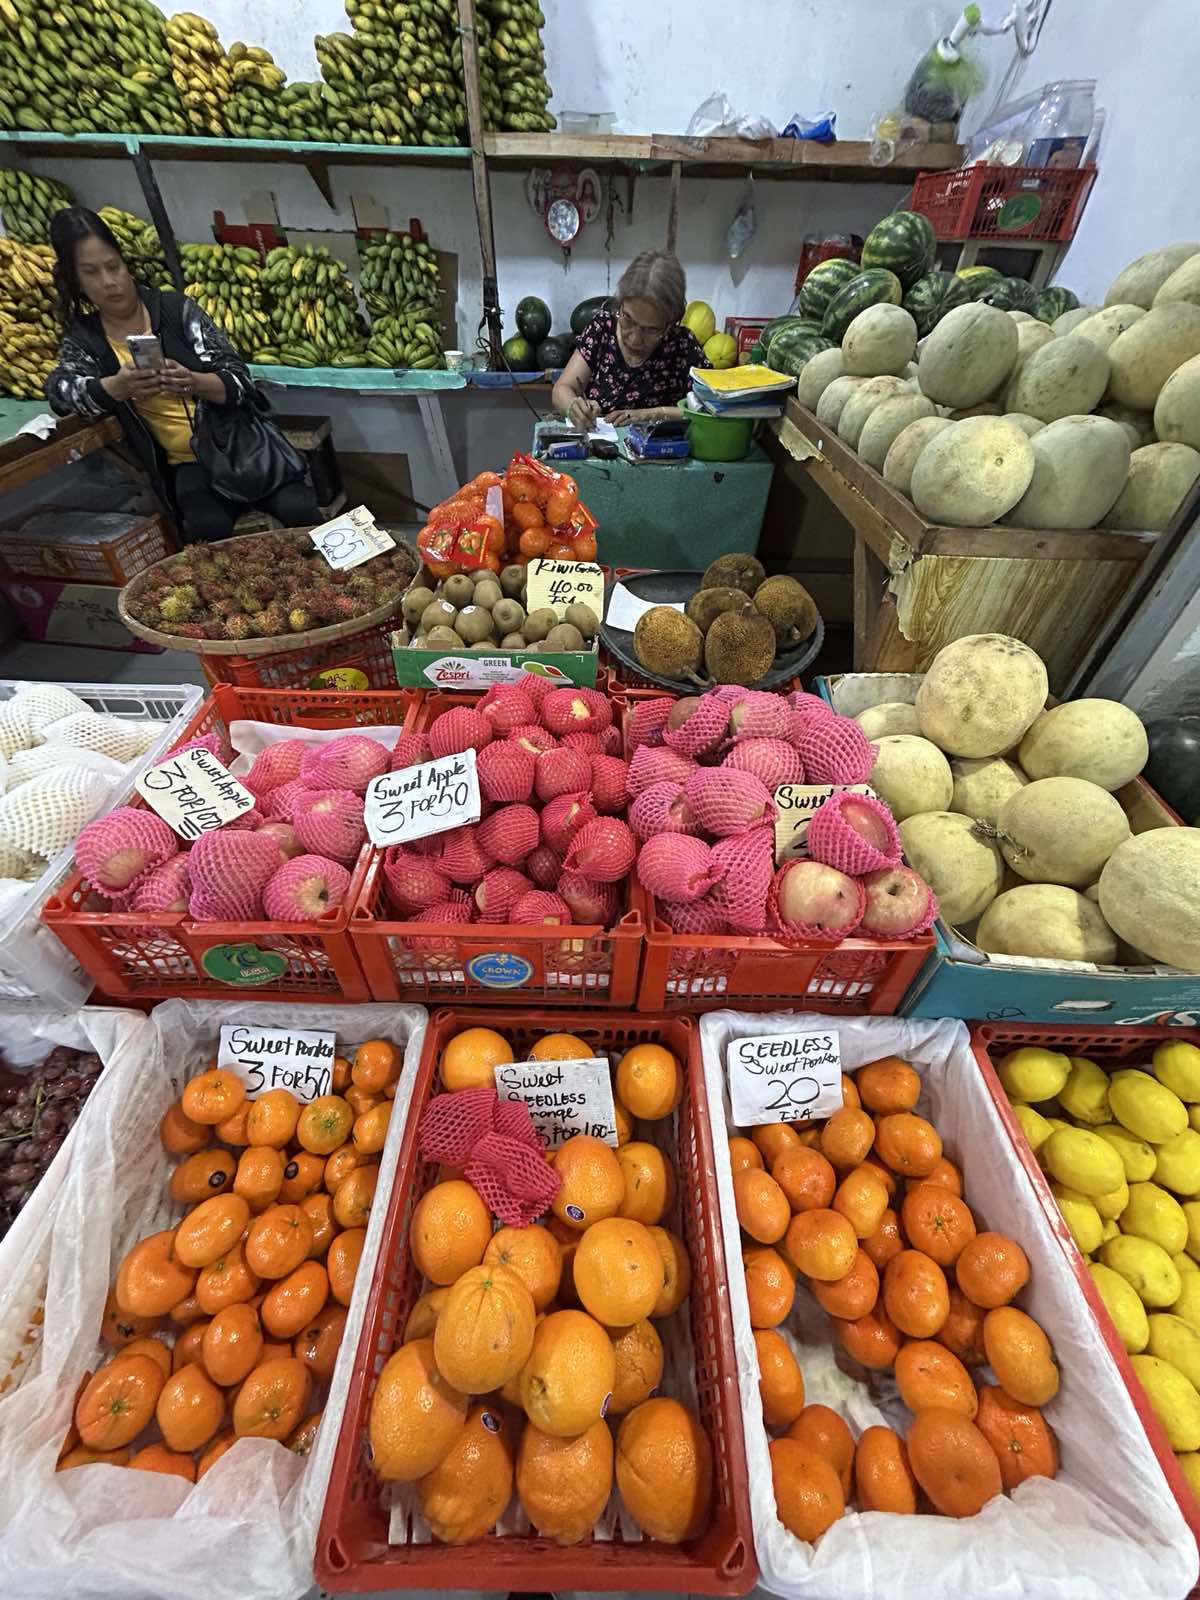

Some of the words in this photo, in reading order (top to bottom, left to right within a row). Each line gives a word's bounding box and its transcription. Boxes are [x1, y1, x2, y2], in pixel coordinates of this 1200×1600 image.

[323, 527, 365, 560] 65
[549, 579, 593, 596] 40.00
[435, 668, 471, 682] Zespri
[483, 659, 507, 667] GREEN
[143, 760, 188, 790] 3
[170, 784, 206, 809] FOR
[373, 777, 422, 800] Sweet
[427, 760, 467, 790] Apple
[376, 800, 405, 833] 3
[411, 795, 437, 819] FOR
[430, 782, 469, 816] 50
[228, 1028, 295, 1055] Sweet
[739, 1035, 833, 1064] SEEDLESS
[238, 1058, 265, 1093] 3
[271, 1065, 304, 1089] FOR
[300, 1065, 331, 1100] 50
[500, 1066, 565, 1090] Sweet
[530, 1107, 579, 1123] range
